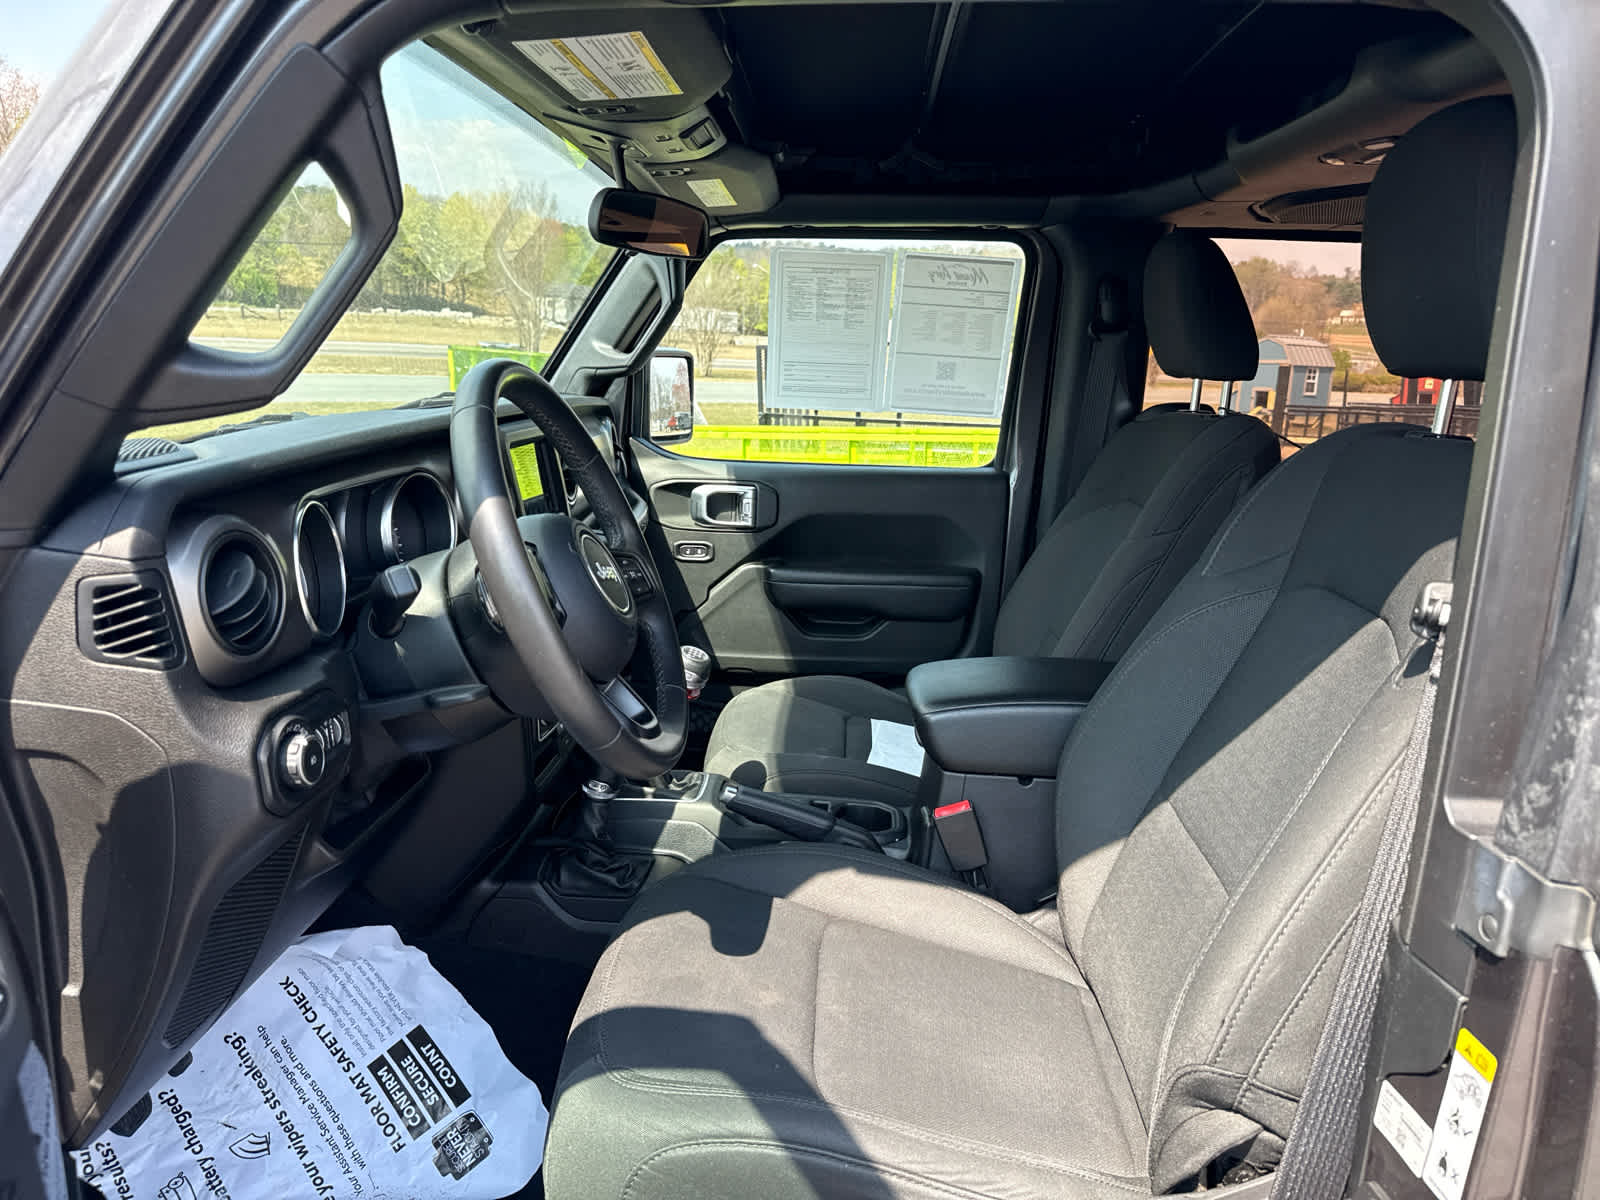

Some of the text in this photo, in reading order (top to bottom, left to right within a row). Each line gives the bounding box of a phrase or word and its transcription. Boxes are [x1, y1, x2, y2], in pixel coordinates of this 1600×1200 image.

[257, 1025, 272, 1048] help
[270, 1046, 282, 1063] can
[224, 1032, 281, 1109] streaking?
[279, 976, 406, 1153] FLOOR MAT SAFETY CHECK
[280, 1065, 310, 1104] Manager
[401, 1055, 439, 1105] SECURE
[421, 1041, 457, 1088] COUNT
[281, 1035, 366, 1170] with these questions and more.
[308, 1103, 330, 1137] Service
[377, 1066, 421, 1127] CONFIRM
[158, 1089, 203, 1155] charged?
[276, 1111, 308, 1160] wipers
[325, 1135, 352, 1174] Assistant
[446, 1128, 475, 1165] NEVER
[95, 1143, 134, 1200] results?
[302, 1162, 333, 1196] your
[348, 1176, 364, 1197] Your
